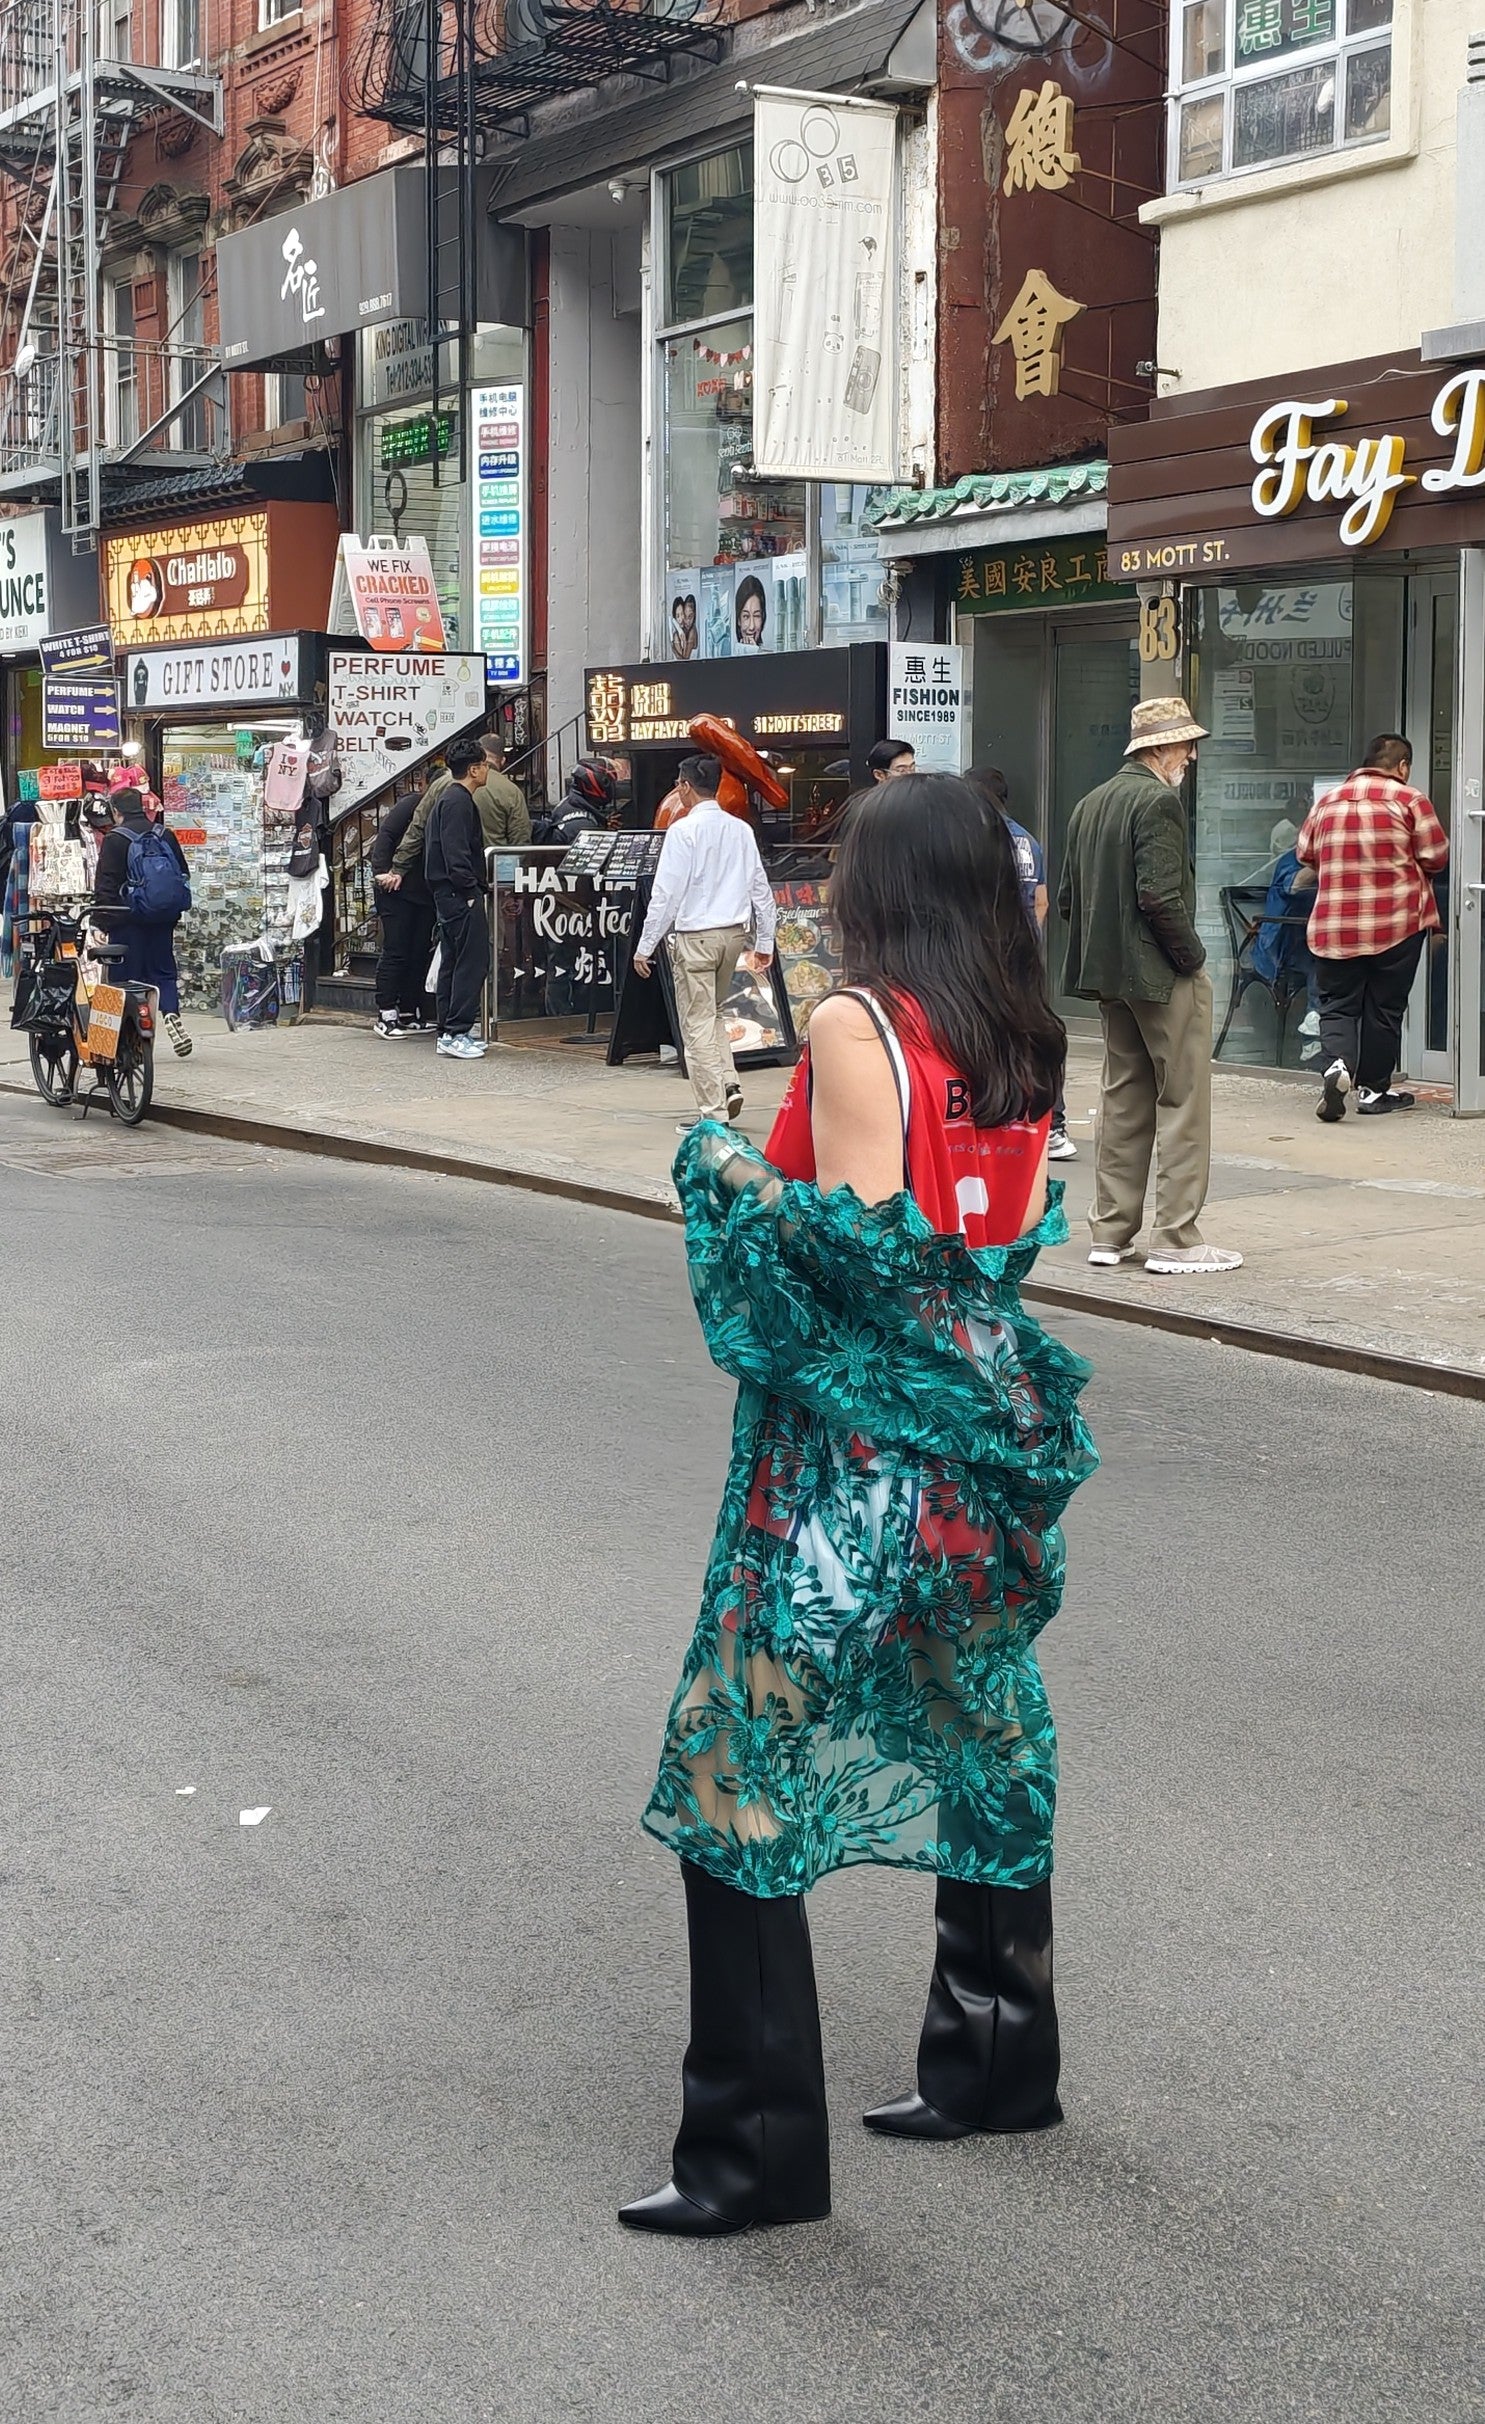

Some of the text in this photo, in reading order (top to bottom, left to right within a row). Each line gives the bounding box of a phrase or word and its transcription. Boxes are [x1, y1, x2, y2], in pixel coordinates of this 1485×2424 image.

[1250, 398, 1414, 547] Fay
[1120, 539, 1231, 573] 83 MOTT ST.
[167, 551, 236, 587] ChaHalo
[367, 560, 413, 573] WE FIX
[355, 575, 431, 596] CRACKED
[1139, 598, 1178, 662] 83
[42, 631, 109, 653] WHITE T-SHIRT
[66, 647, 82, 657] FOR
[163, 652, 273, 696] GIFT STORE
[333, 657, 446, 676] PERFUME
[904, 656, 952, 684] 惠生
[47, 685, 94, 697] PERFUME
[334, 685, 421, 701] T-SHIRT
[893, 688, 960, 706] FISHION
[47, 704, 85, 715] WATCH
[897, 710, 956, 723] SINCE1989
[334, 711, 413, 727] WATCH
[47, 723, 90, 734] MAGNET
[336, 737, 378, 752] BELT
[281, 753, 286, 762] I
[278, 765, 298, 777] NY
